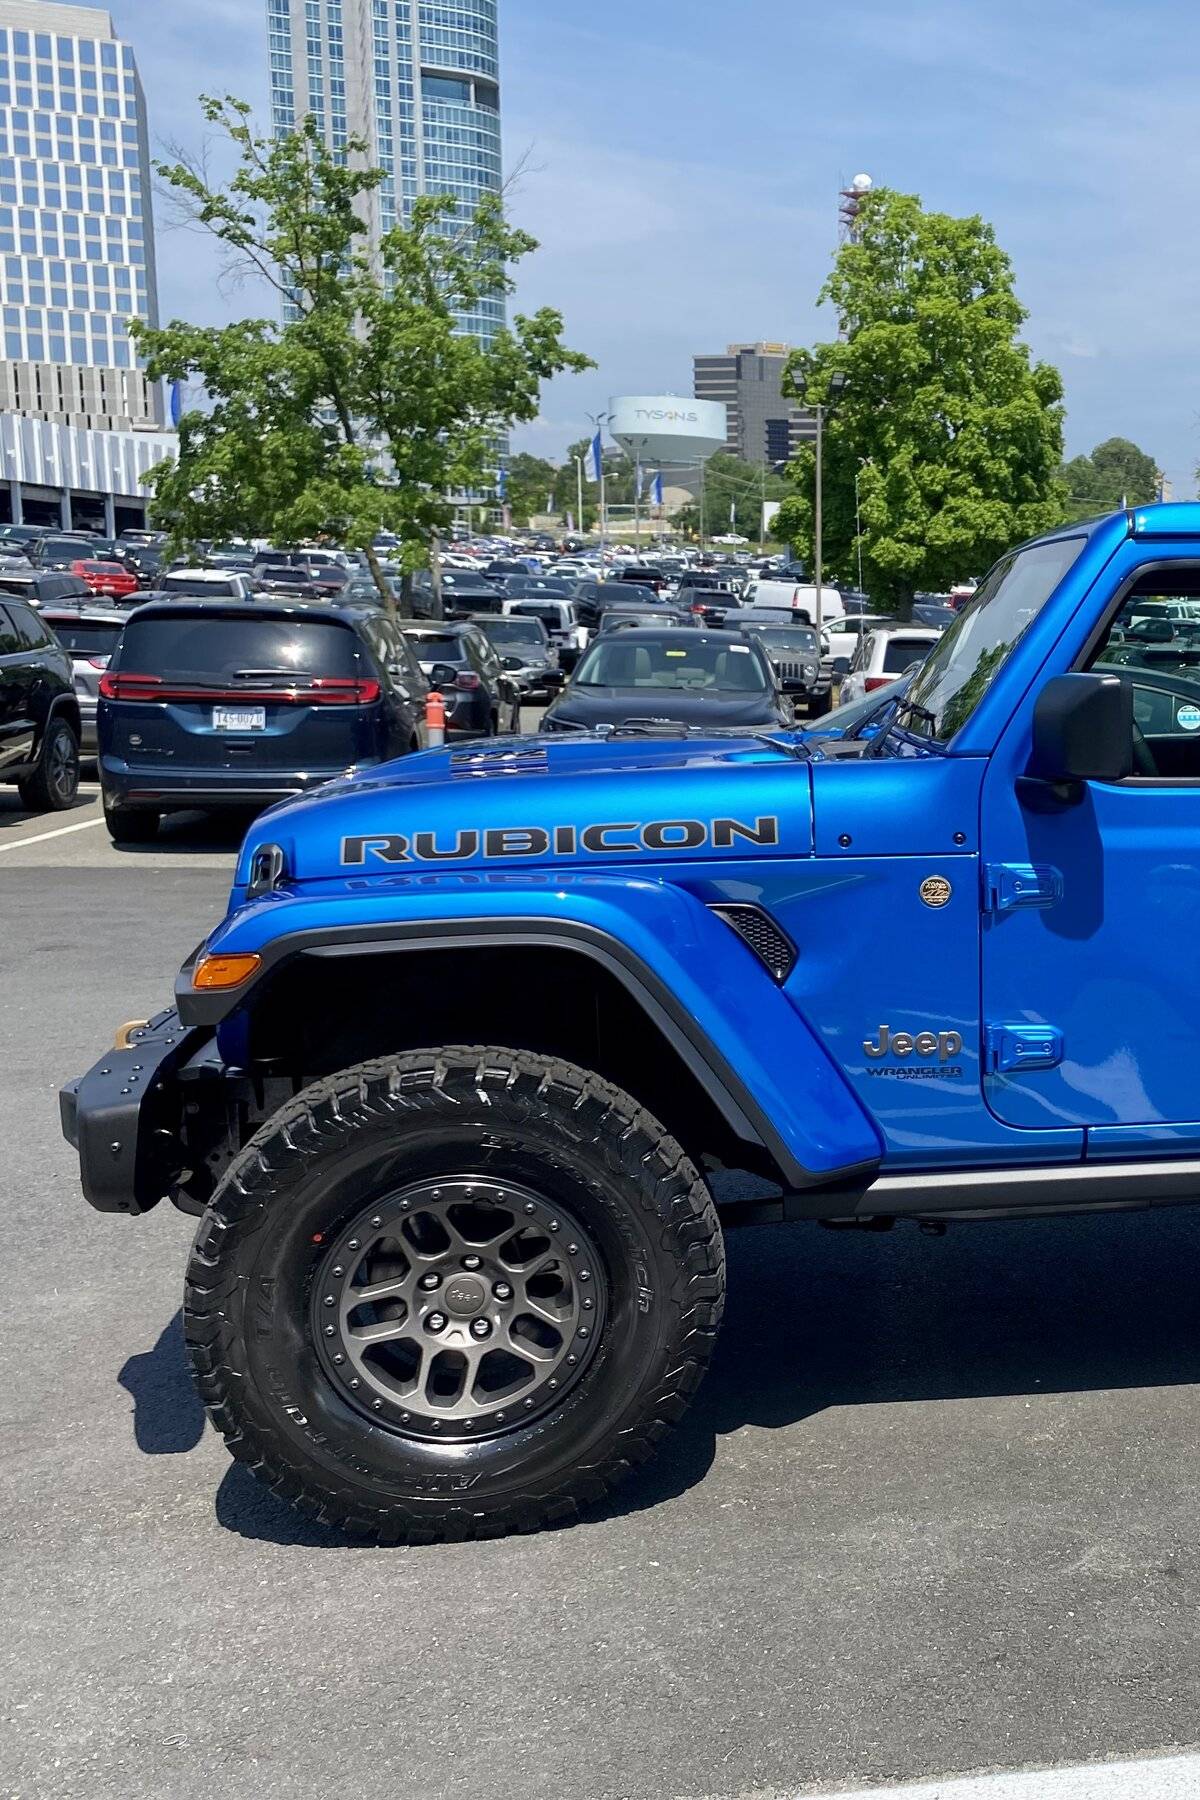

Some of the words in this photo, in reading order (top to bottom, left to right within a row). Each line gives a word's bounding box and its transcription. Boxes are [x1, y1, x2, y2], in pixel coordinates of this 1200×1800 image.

[634, 409, 698, 421] TYSONS
[340, 816, 779, 865] RUBICON
[863, 1024, 962, 1062] Jeep
[865, 1066, 963, 1076] WRANGLER
